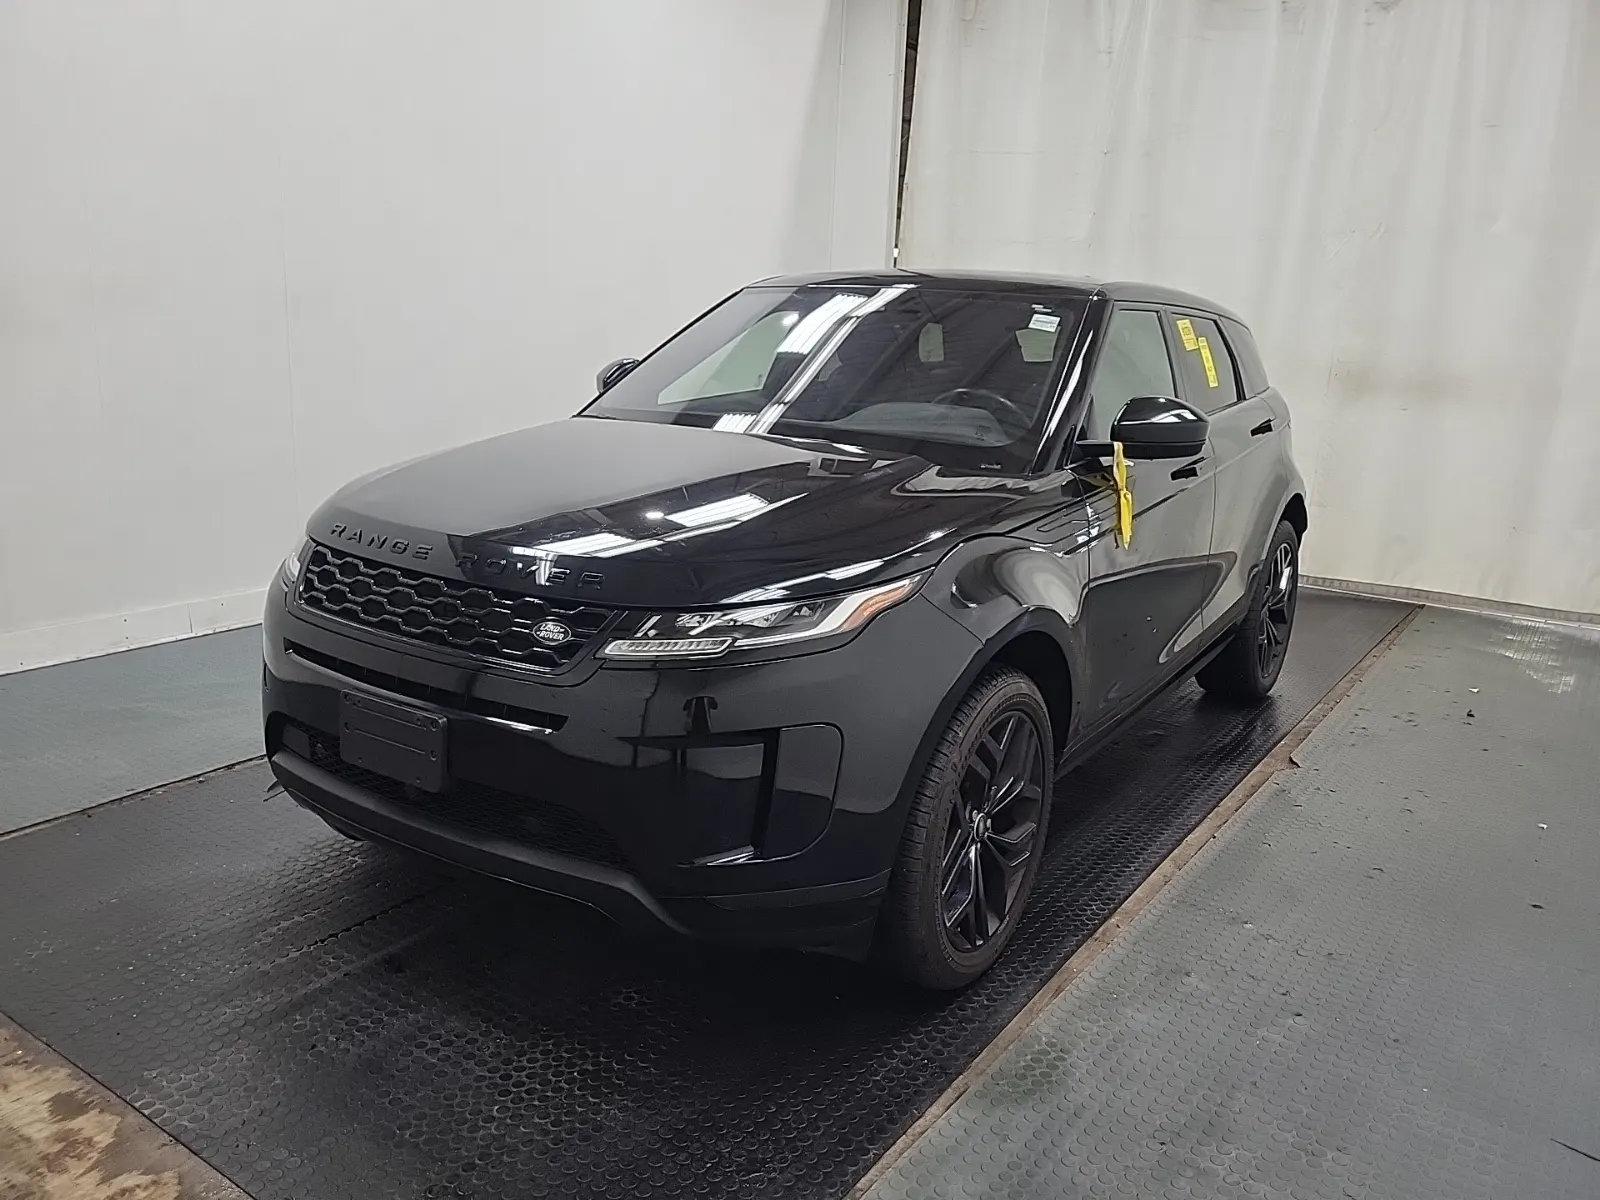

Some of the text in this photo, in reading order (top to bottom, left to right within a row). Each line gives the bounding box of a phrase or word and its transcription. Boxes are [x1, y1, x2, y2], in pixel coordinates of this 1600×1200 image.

[329, 523, 605, 590] RANGE ROVER
[540, 623, 561, 632] LAND
[539, 631, 565, 641] ROVER
